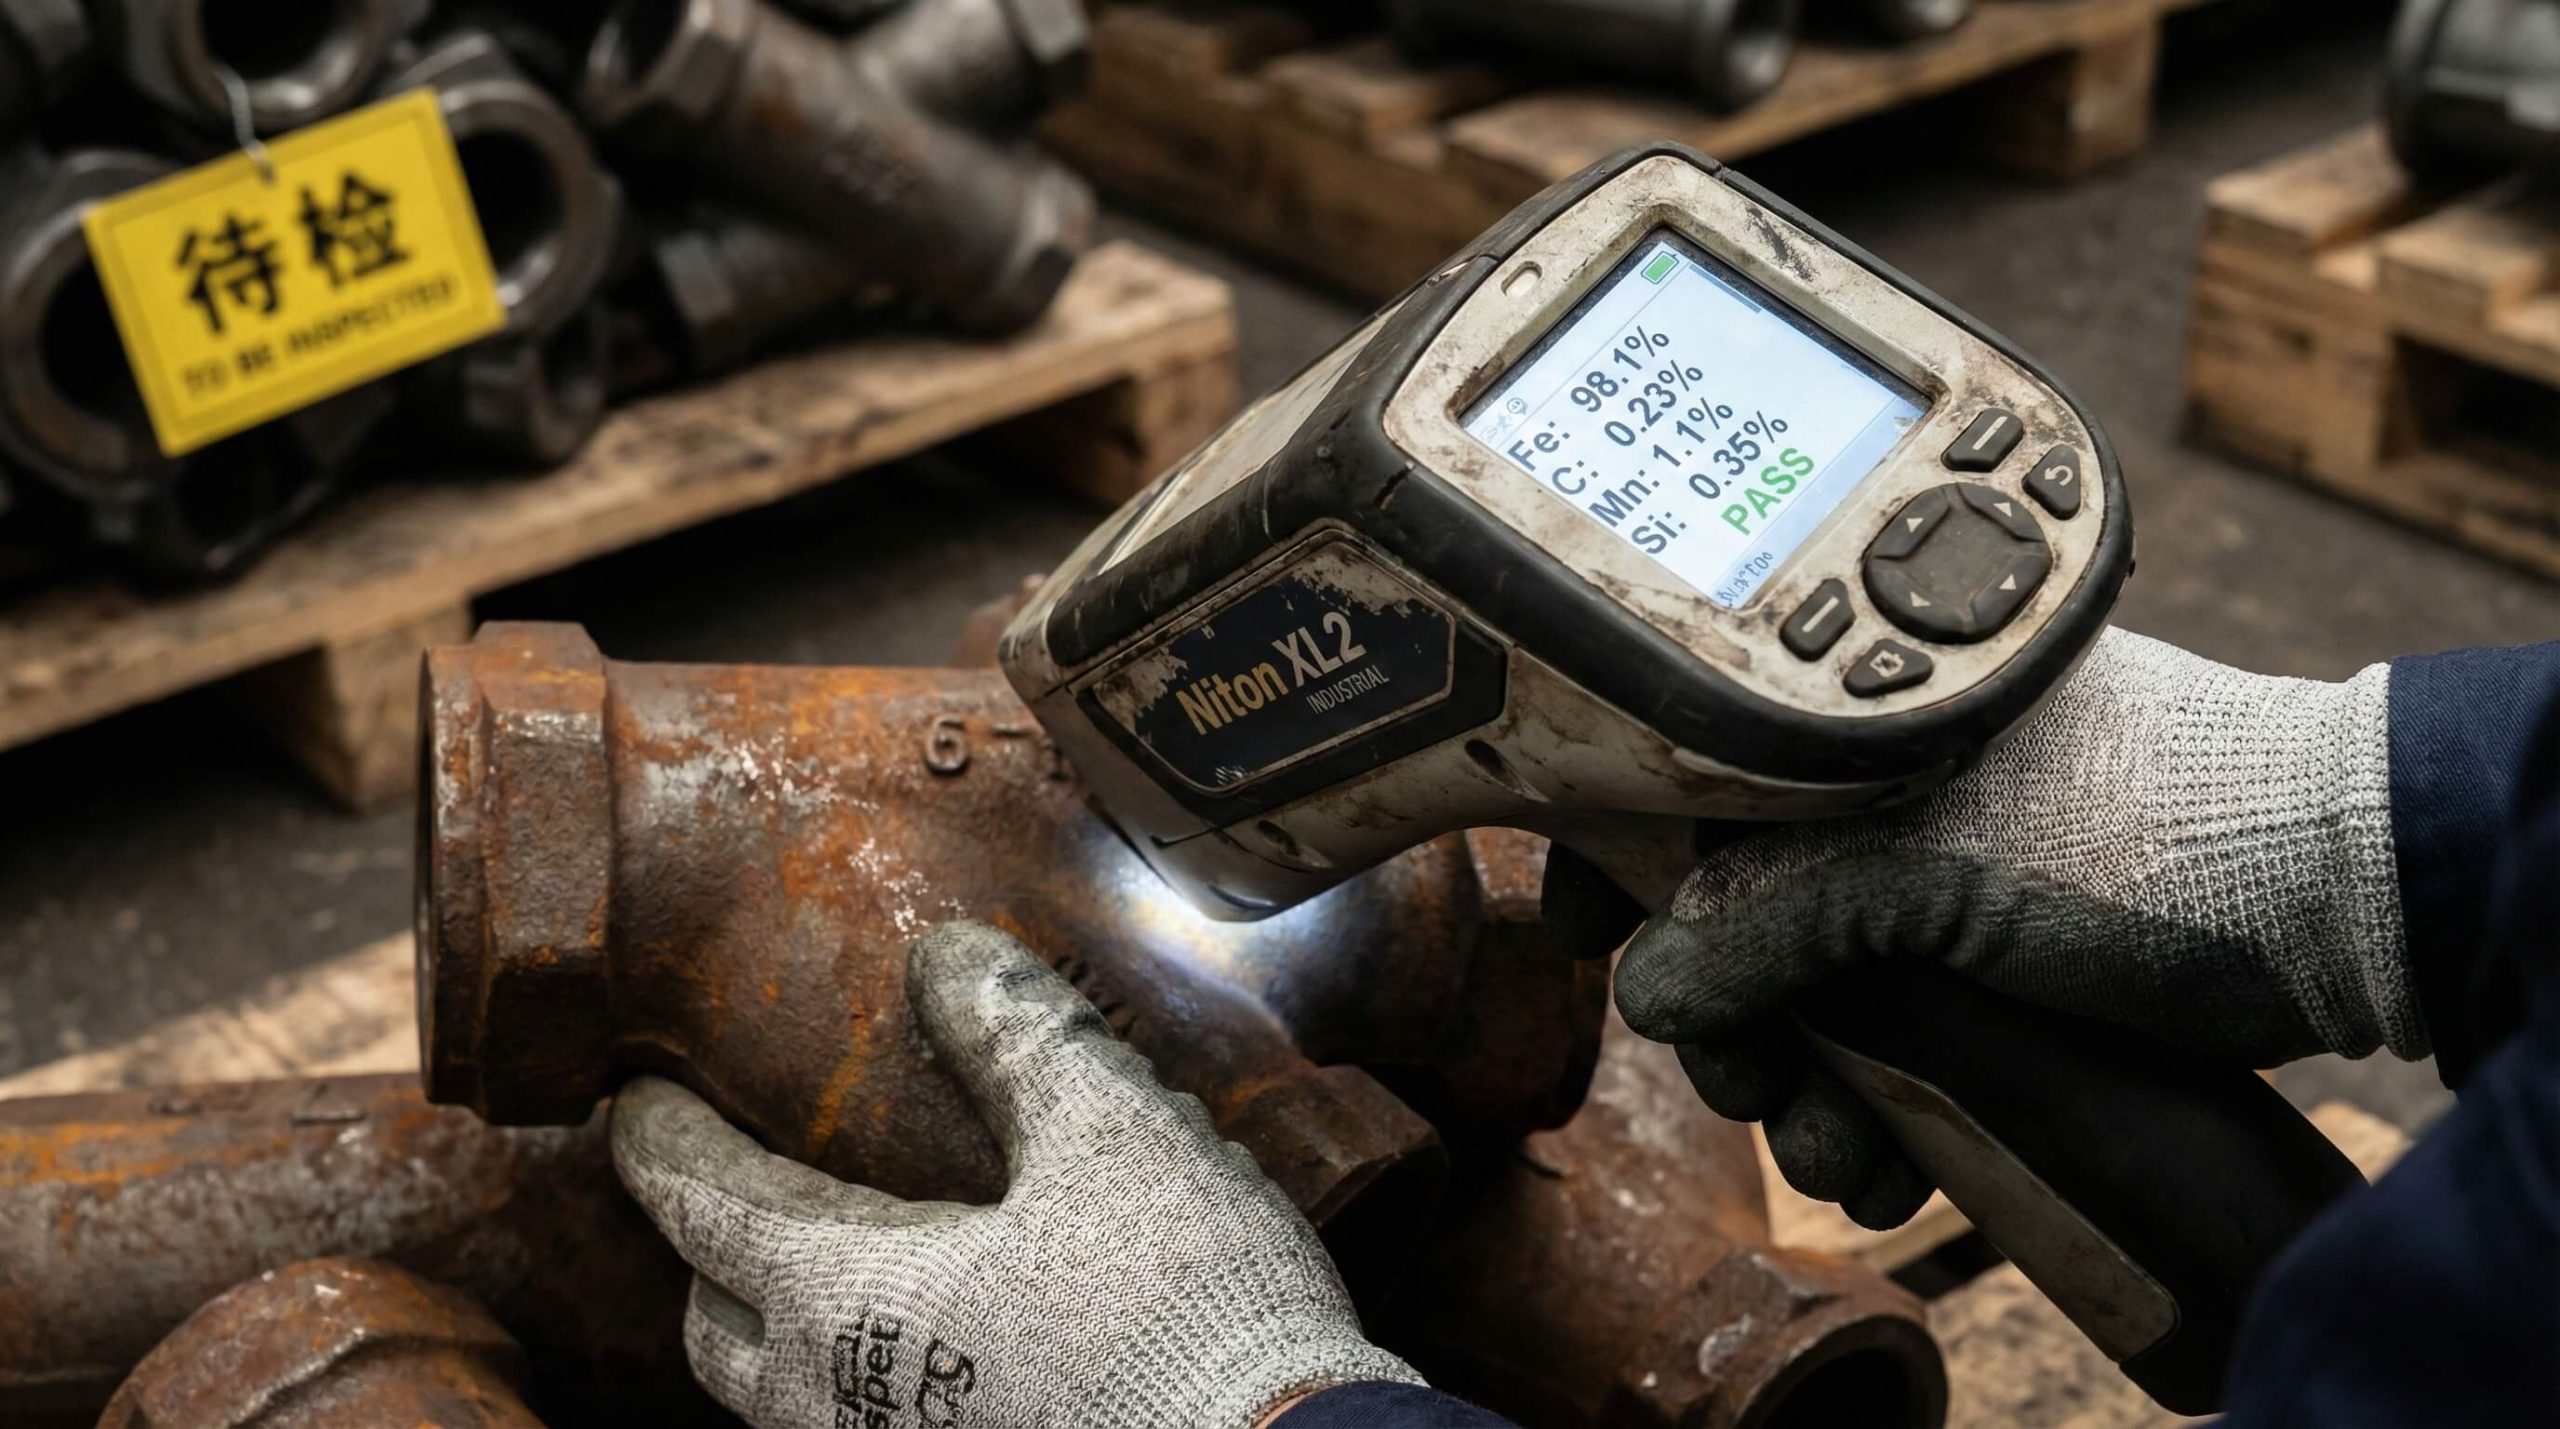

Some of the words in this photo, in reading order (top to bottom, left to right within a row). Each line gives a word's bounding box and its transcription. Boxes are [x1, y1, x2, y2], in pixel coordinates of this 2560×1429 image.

[174, 169, 412, 336] 待检
[1507, 421, 1570, 471] Fe:
[1570, 325, 1670, 413] 98.1%
[1552, 460, 1599, 496] C:
[1605, 359, 1703, 447] 0.23%
[1588, 468, 1660, 527] Mn:
[1653, 397, 1734, 468] 1.1%
[1631, 511, 1687, 556] Si:
[1688, 410, 1789, 500] 0.35%
[1720, 447, 1815, 536] PASS
[1176, 661, 1289, 736] Niton
[1271, 611, 1367, 688] XL2
[1306, 664, 1390, 714] INDUSTRIAL
